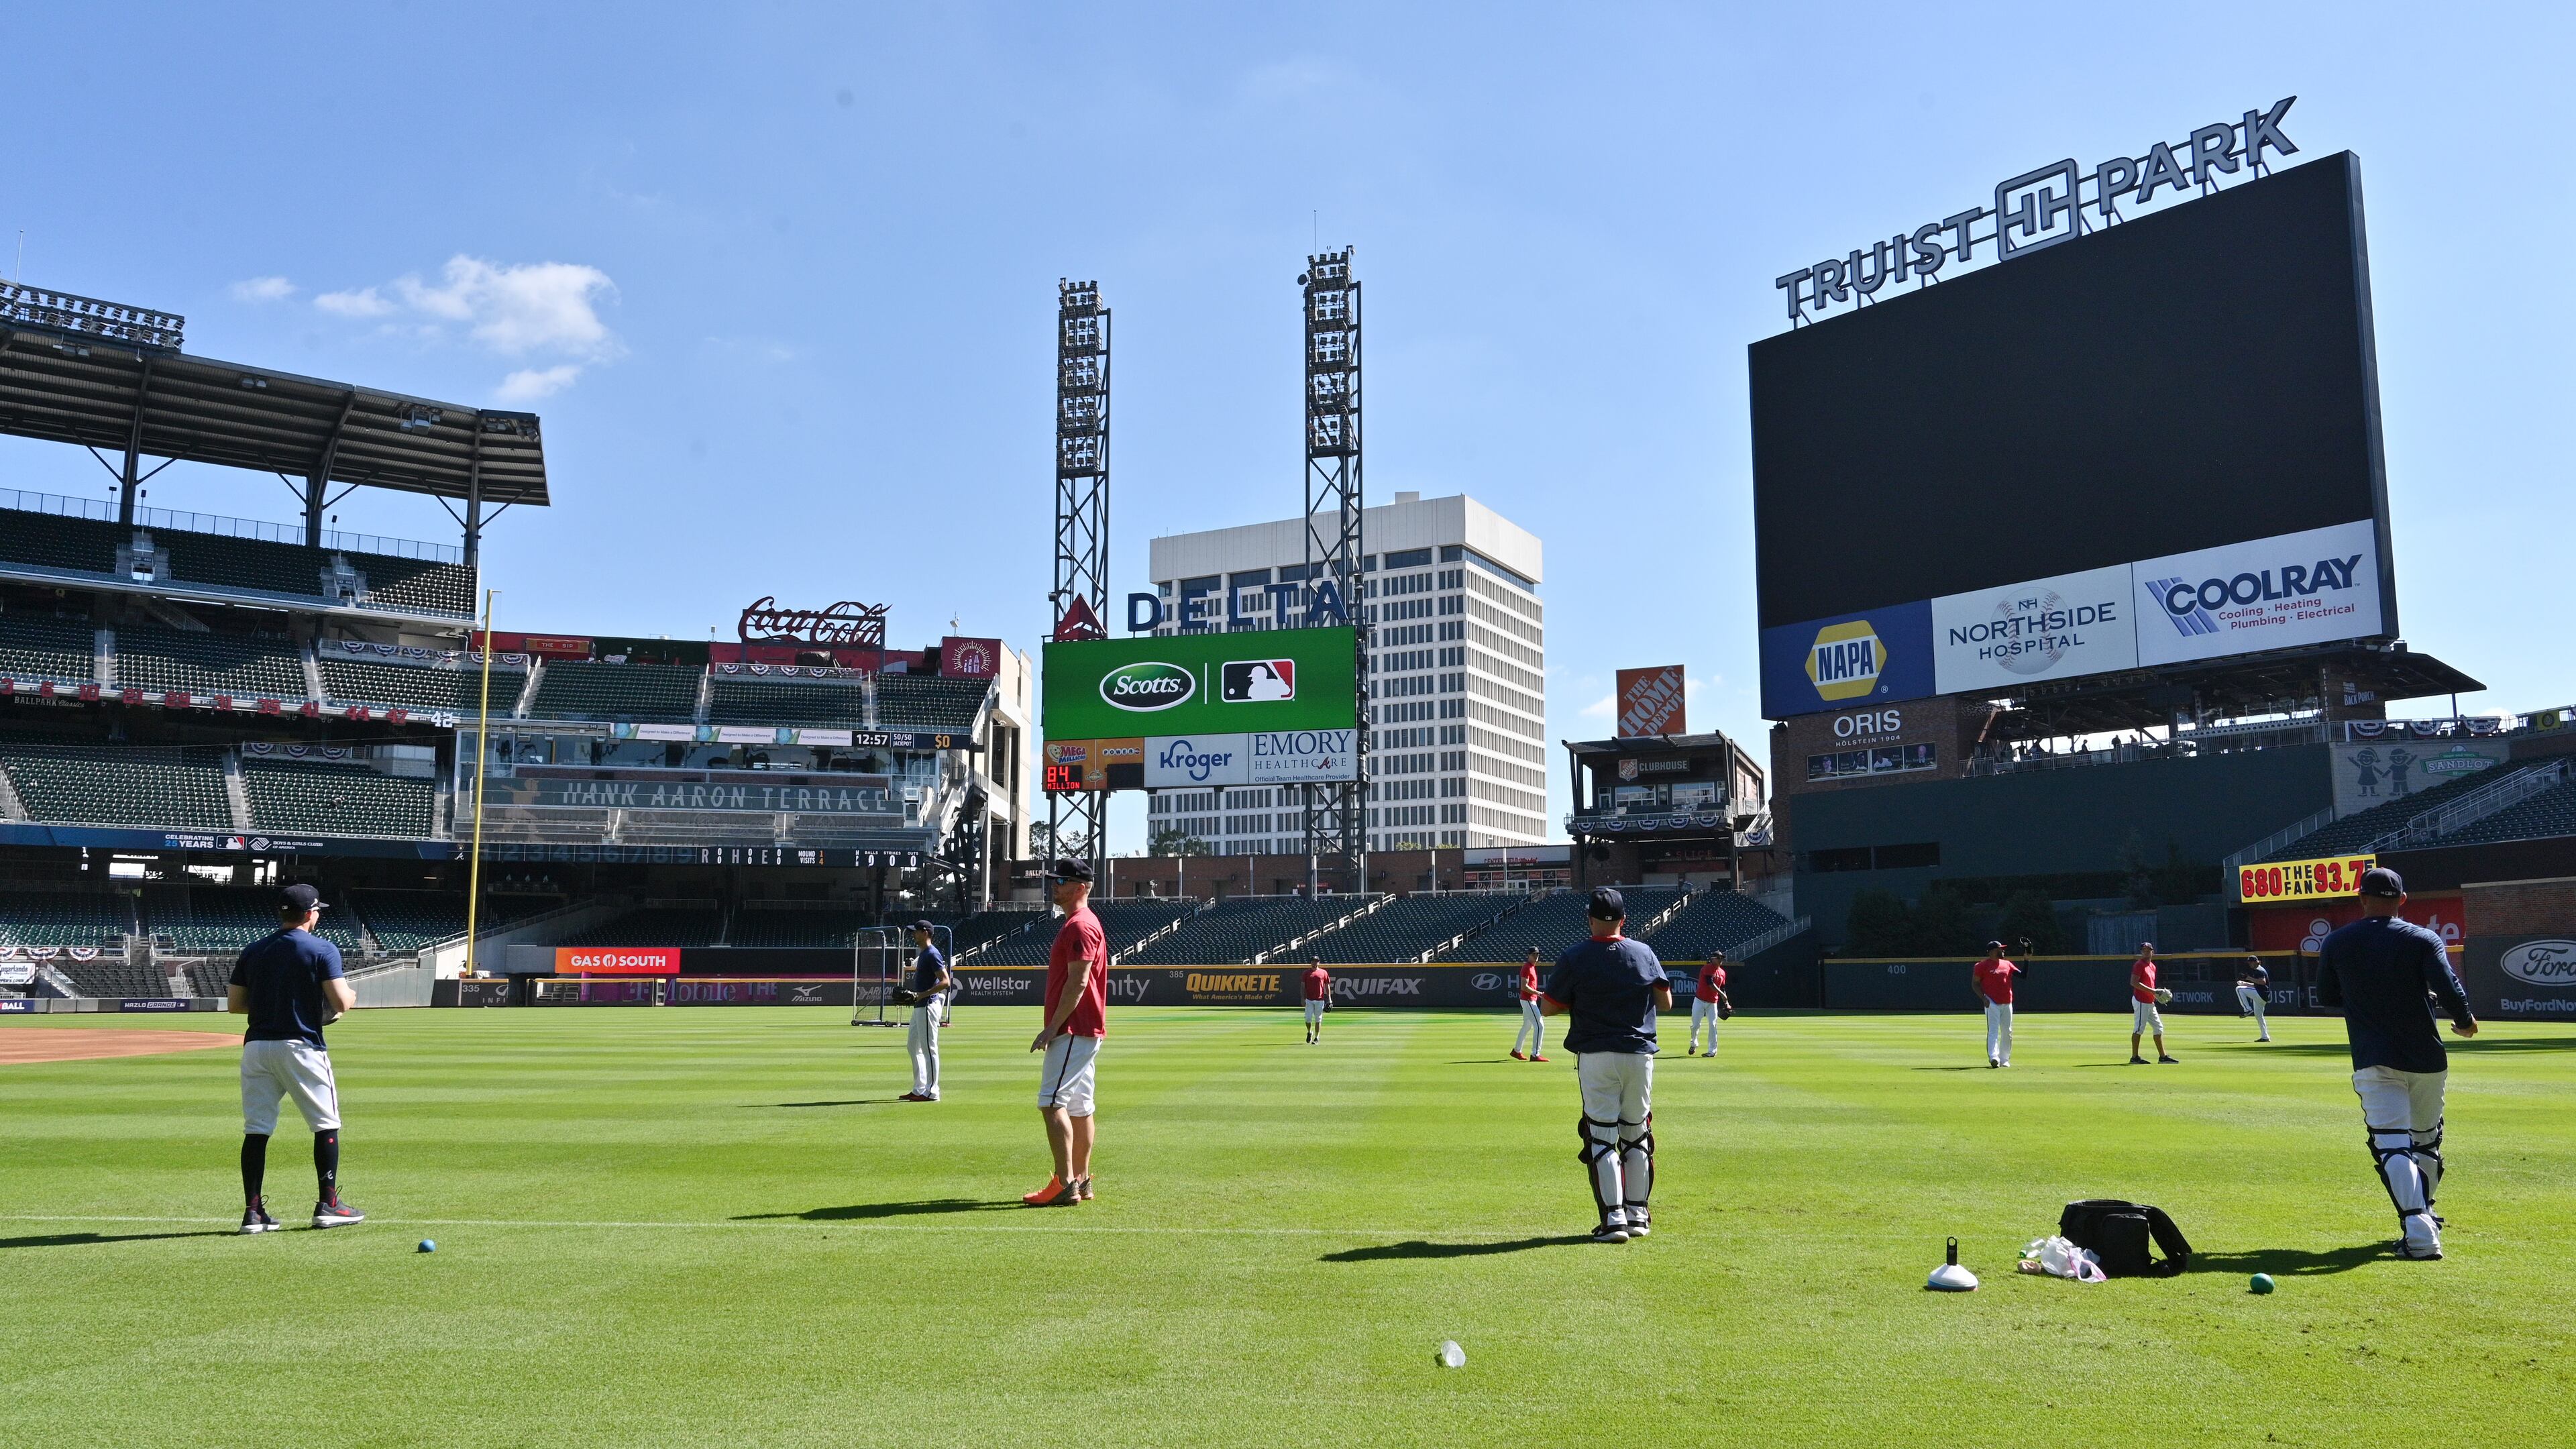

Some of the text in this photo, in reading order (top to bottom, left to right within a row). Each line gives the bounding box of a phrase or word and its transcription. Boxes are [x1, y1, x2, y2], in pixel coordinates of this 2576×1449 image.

[1776, 95, 2300, 318] TRUIST PARK
[2165, 554, 2363, 615] COOLRAY
[1128, 581, 1350, 631] DELTA
[2218, 598, 2322, 621] Cooling Heating
[738, 596, 893, 647] Coca-Cola
[1949, 602, 2116, 646] NORTHSIDE
[2231, 604, 2355, 630] Plumbing Electrical
[1980, 633, 2085, 659] HOSPITAL
[1818, 640, 1874, 682] NAPA
[41, 681, 54, 698] 6
[79, 684, 99, 701] 10
[1114, 676, 1181, 696] Scotts
[1623, 676, 1652, 704] THE
[14, 696, 58, 706] BALLPARK
[123, 688, 143, 705] 21
[165, 690, 191, 708] 29
[215, 694, 232, 711] 31
[1619, 666, 1684, 737] HOME
[2344, 691, 2374, 706] BACK PORCH
[258, 698, 281, 714] 35
[301, 702, 320, 718] 41
[346, 705, 370, 721] 44
[1644, 691, 1684, 736] DEPOT
[386, 708, 409, 724] 47
[431, 711, 453, 728] 42
[1833, 710, 1901, 737] ORIS
[857, 734, 888, 745] 12:57
[894, 733, 912, 741] 50/50
[935, 734, 950, 749] $0
[1254, 731, 1351, 756] EMORY
[1061, 746, 1085, 757] MEGA
[1160, 740, 1232, 781] Kroger
[1255, 756, 1347, 769] HEALTHCARE
[1639, 760, 1688, 771] CLUBHOUSE
[2428, 760, 2493, 771] SANDLOT
[1047, 766, 1069, 782] 84
[563, 782, 887, 810] HANK AARON TERRACE
[504, 844, 519, 860] 2
[529, 844, 544, 861] 3
[553, 845, 569, 861] 4
[580, 845, 594, 861] 5
[702, 849, 709, 863] R
[732, 849, 739, 863] H
[761, 850, 767, 864] E
[889, 855, 895, 866] 0
[910, 855, 916, 866] 0
[2283, 865, 2312, 880] THE
[2314, 860, 2364, 893] 93.7
[2241, 867, 2282, 898] 680
[2285, 880, 2313, 896] FAN
[0, 965, 28, 974] ugarlands
[571, 955, 666, 967] GAS SOUTH
[1887, 965, 1907, 974] 400
[462, 985, 480, 993] 335
[968, 977, 1031, 990] Wellstar
[1107, 973, 1150, 1002] nity
[1186, 973, 1280, 992] QUIKRETE
[1330, 977, 1423, 1000] EQUIFAX
[1672, 979, 1697, 993] JOHN
[2172, 991, 2213, 1003] NETWORK
